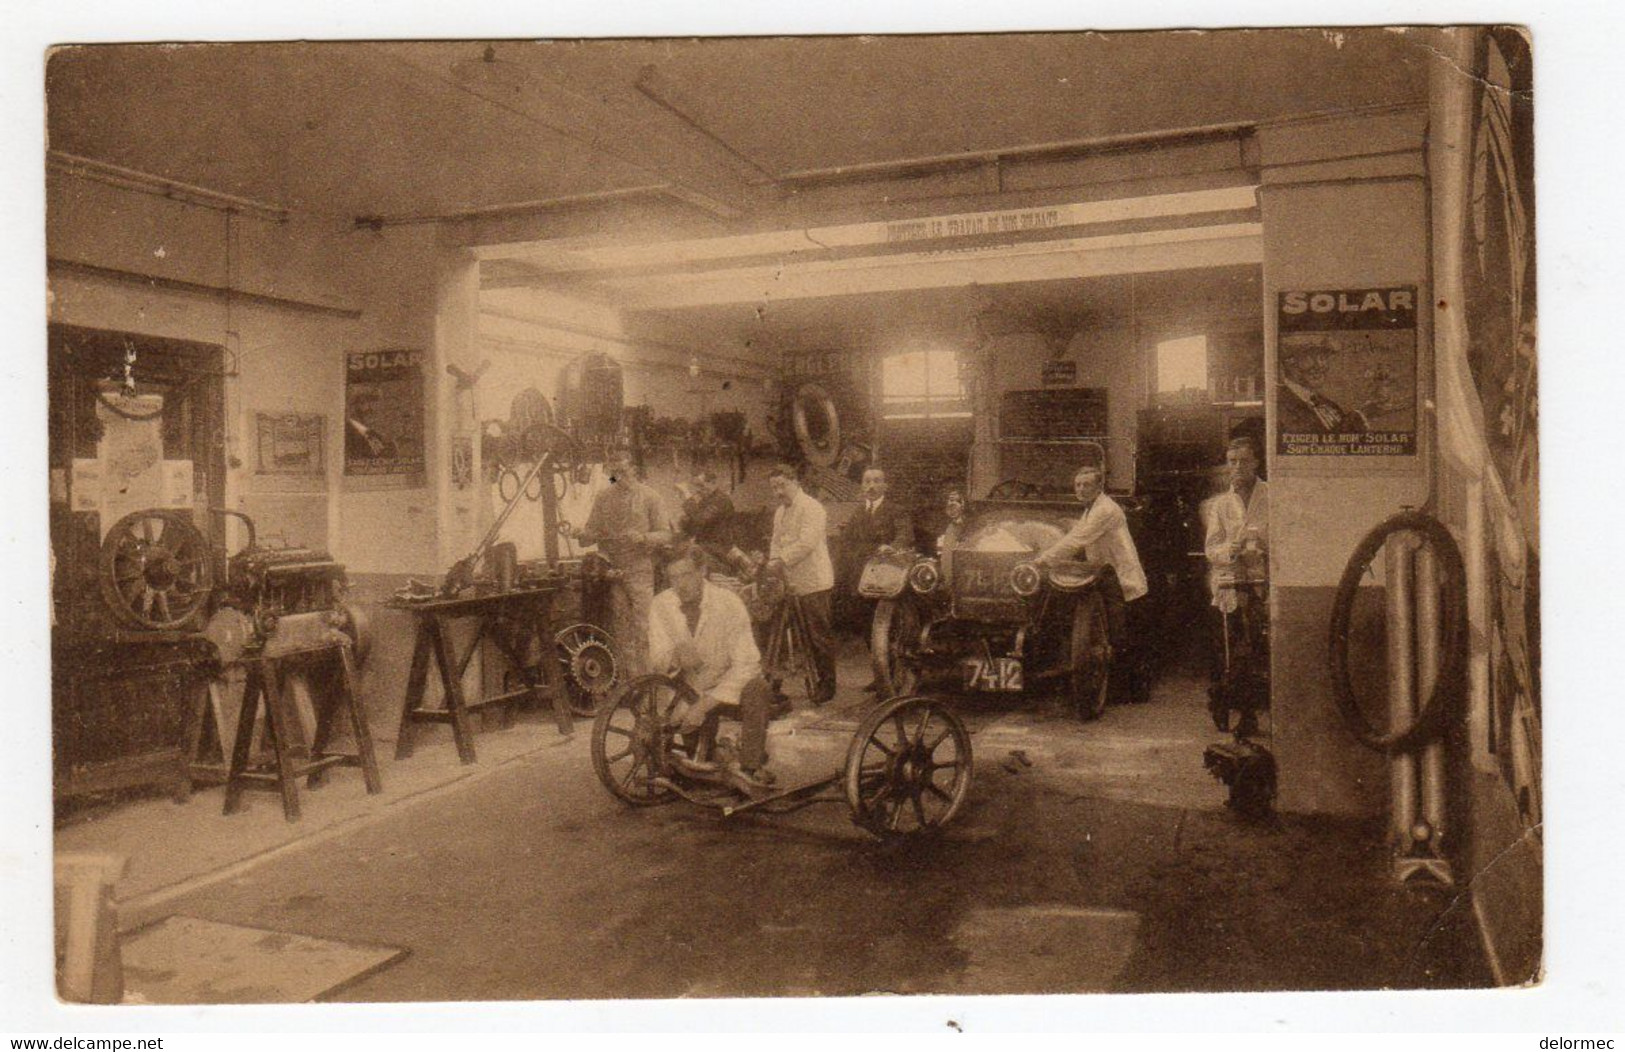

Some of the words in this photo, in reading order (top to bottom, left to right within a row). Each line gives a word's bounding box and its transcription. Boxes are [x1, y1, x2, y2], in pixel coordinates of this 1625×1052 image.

[1282, 290, 1413, 314] SOLAR
[349, 353, 423, 370] SOLAR
[966, 661, 1023, 689] 7412
